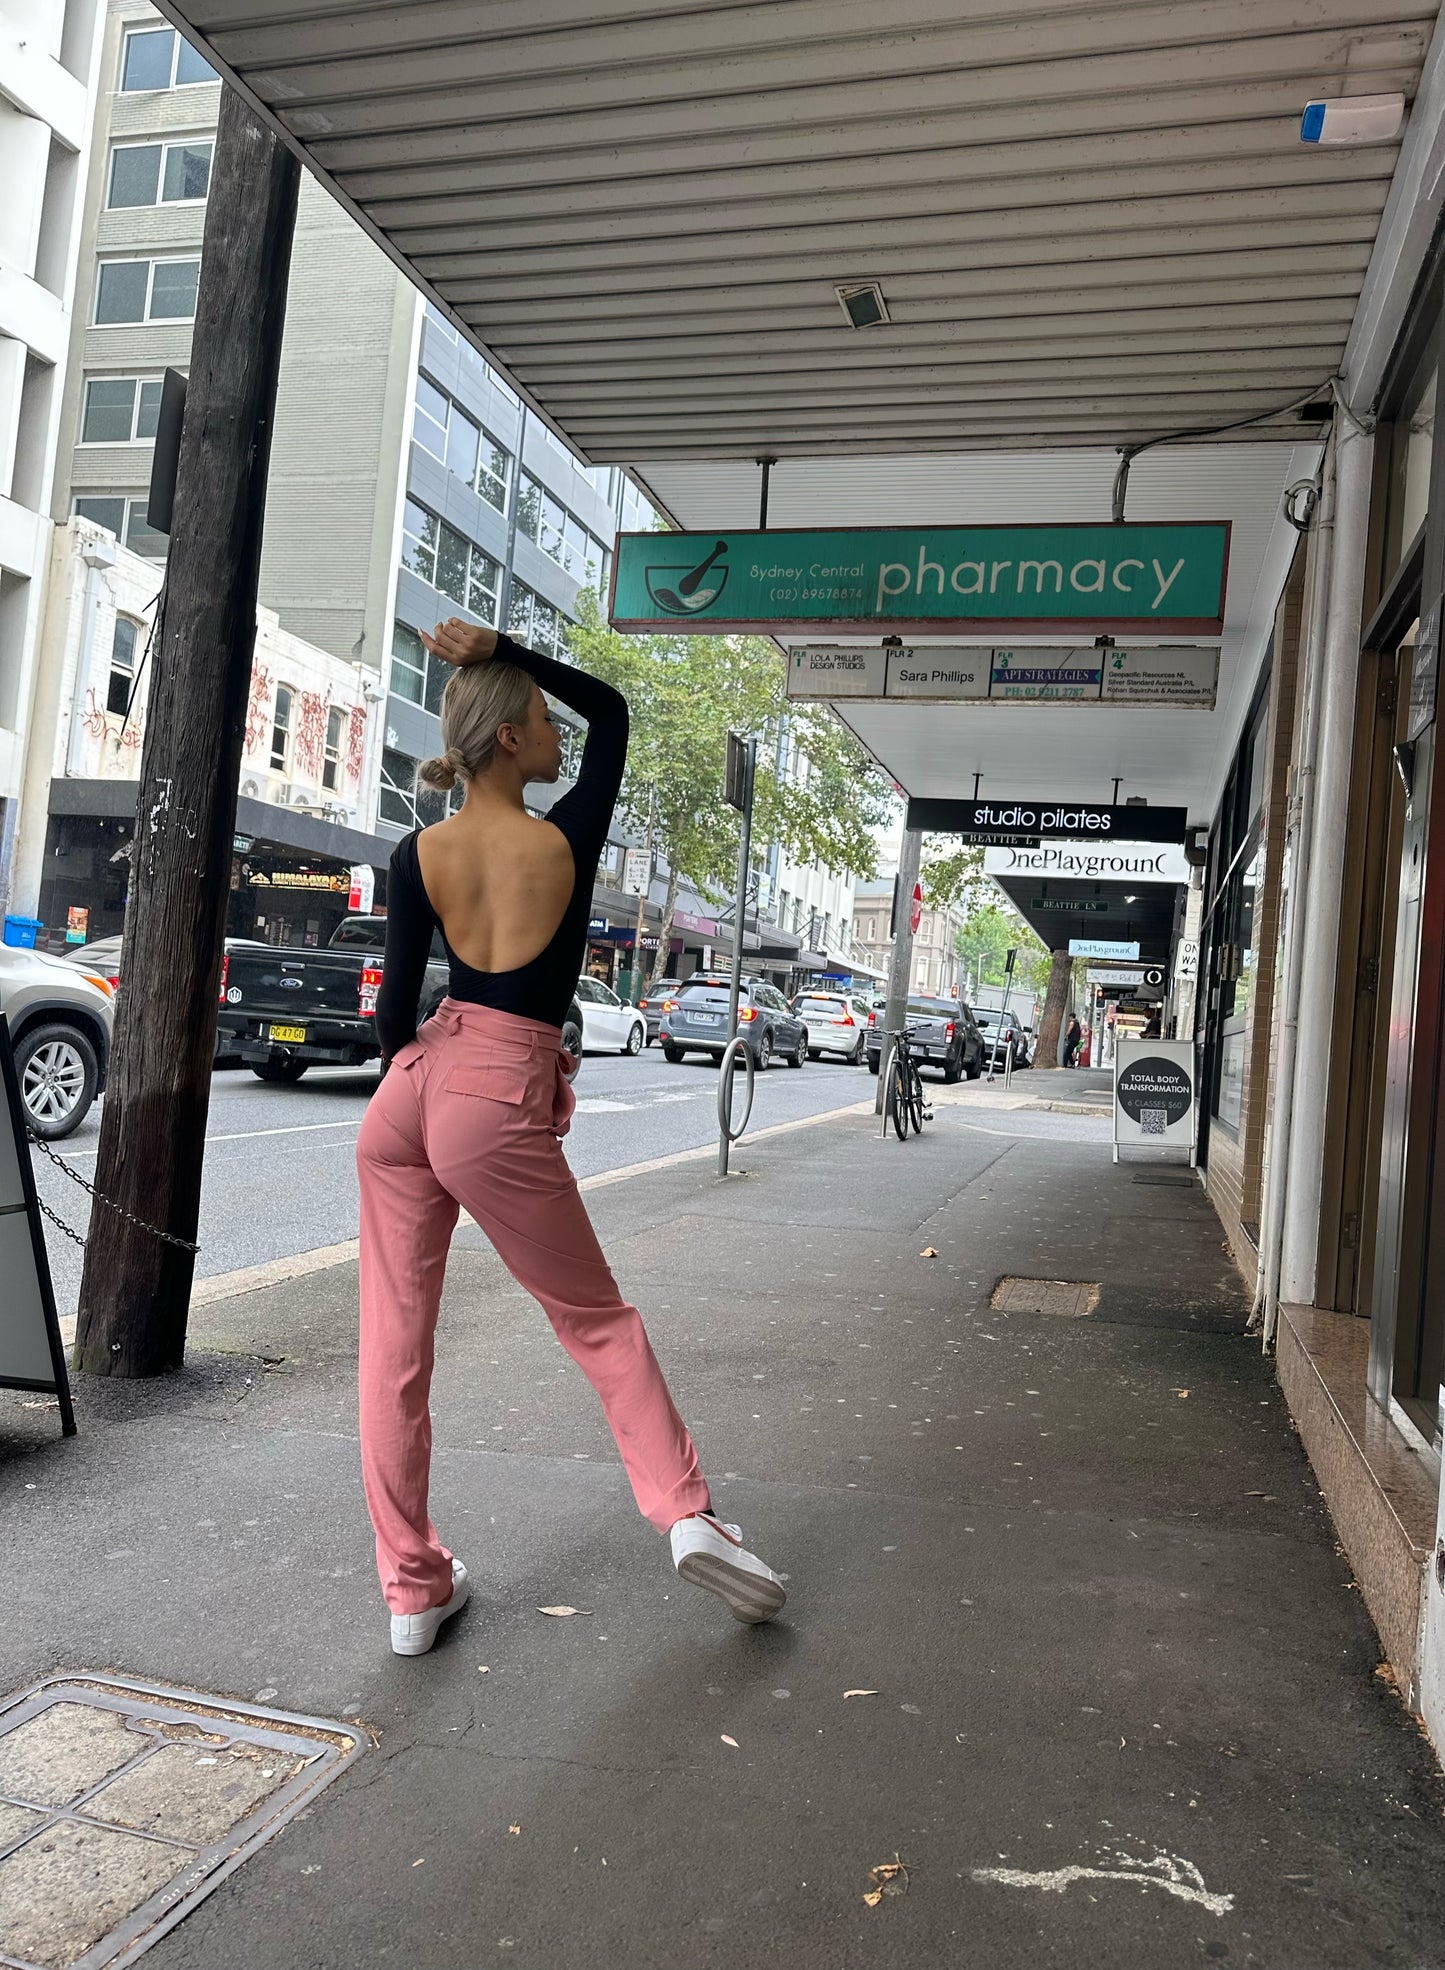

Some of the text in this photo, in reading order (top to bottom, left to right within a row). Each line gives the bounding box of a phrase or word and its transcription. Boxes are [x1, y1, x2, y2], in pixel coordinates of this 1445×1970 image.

[750, 563, 864, 582] Sydney Central
[876, 545, 1185, 613] pharmacy
[770, 588, 797, 602] (02)
[811, 654, 864, 663] LOLA PHILLIPS
[890, 650, 914, 658] FLR 2
[1111, 652, 1127, 660] FLR
[796, 658, 801, 667] 1
[810, 662, 865, 670] DESIGN STUDIOS
[1001, 658, 1009, 668] 3
[1113, 659, 1123, 670] 4
[900, 670, 975, 685] Sara Phillips
[1002, 670, 1089, 681] APT STRATEGIES
[1108, 672, 1141, 680] Geopacific
[1005, 687, 1085, 697] PH: 02 9211 2787
[974, 805, 1111, 831] studio pilates
[969, 834, 1018, 844] BEATTIE
[1043, 900, 1097, 911] BEATTIE LN
[590, 920, 604, 928] ATM
[1184, 943, 1197, 953] ON
[1182, 955, 1196, 966] WA
[1130, 1074, 1180, 1084] TOTAL BODY
[1120, 1083, 1190, 1094] TRANSFORMATION
[1134, 1100, 1166, 1109] CLASSES
